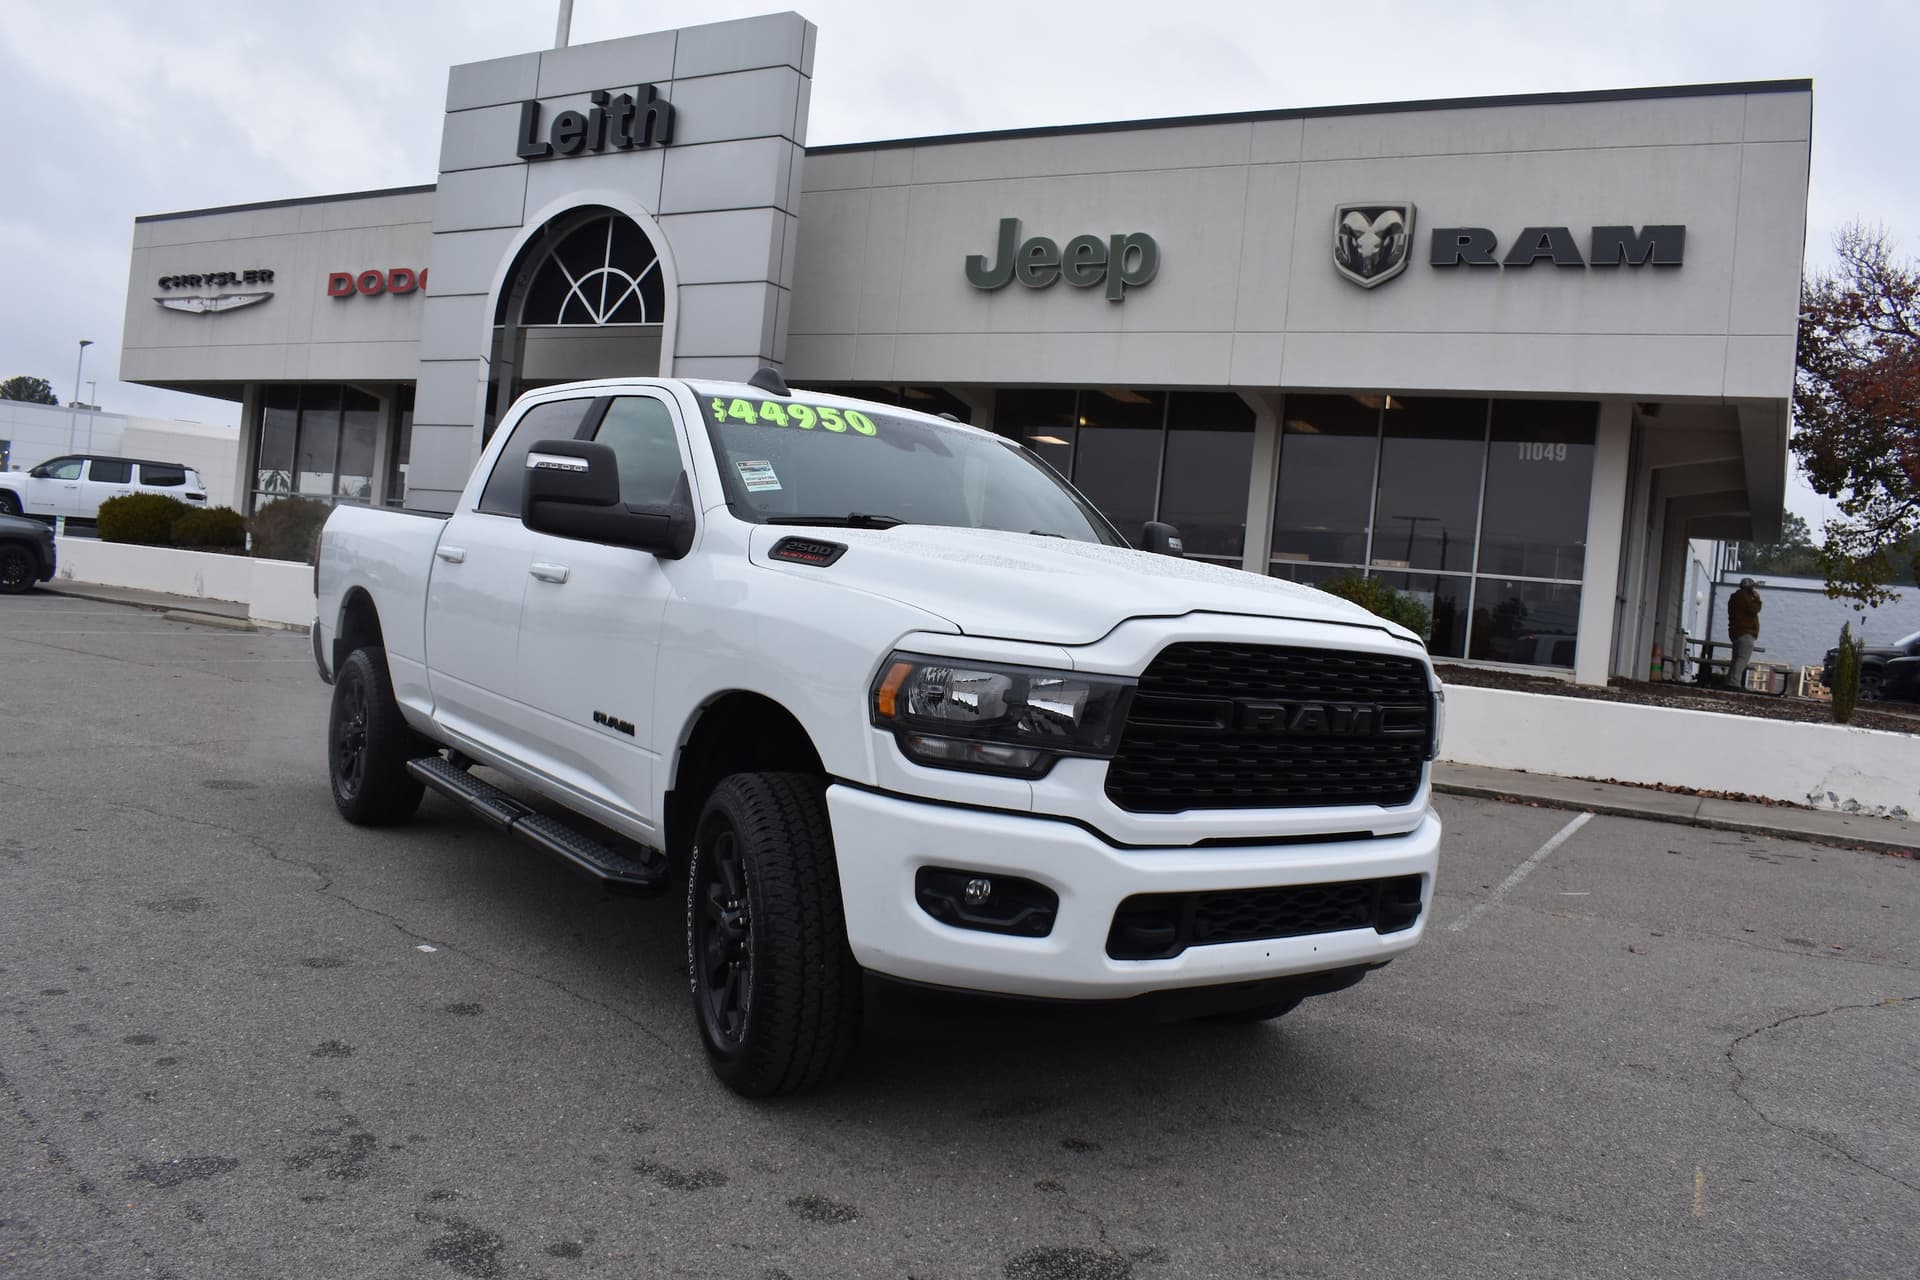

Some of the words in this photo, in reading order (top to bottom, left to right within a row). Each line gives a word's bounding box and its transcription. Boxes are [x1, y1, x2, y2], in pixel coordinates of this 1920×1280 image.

[517, 83, 676, 159] Leith
[965, 217, 1161, 302] Jeep
[1430, 225, 1686, 267] RAM
[158, 268, 275, 291] CHRYSLER
[711, 397, 877, 436] $44950
[1518, 442, 1567, 461] 11049
[593, 710, 635, 736] RAM
[1243, 704, 1374, 734] RAM
